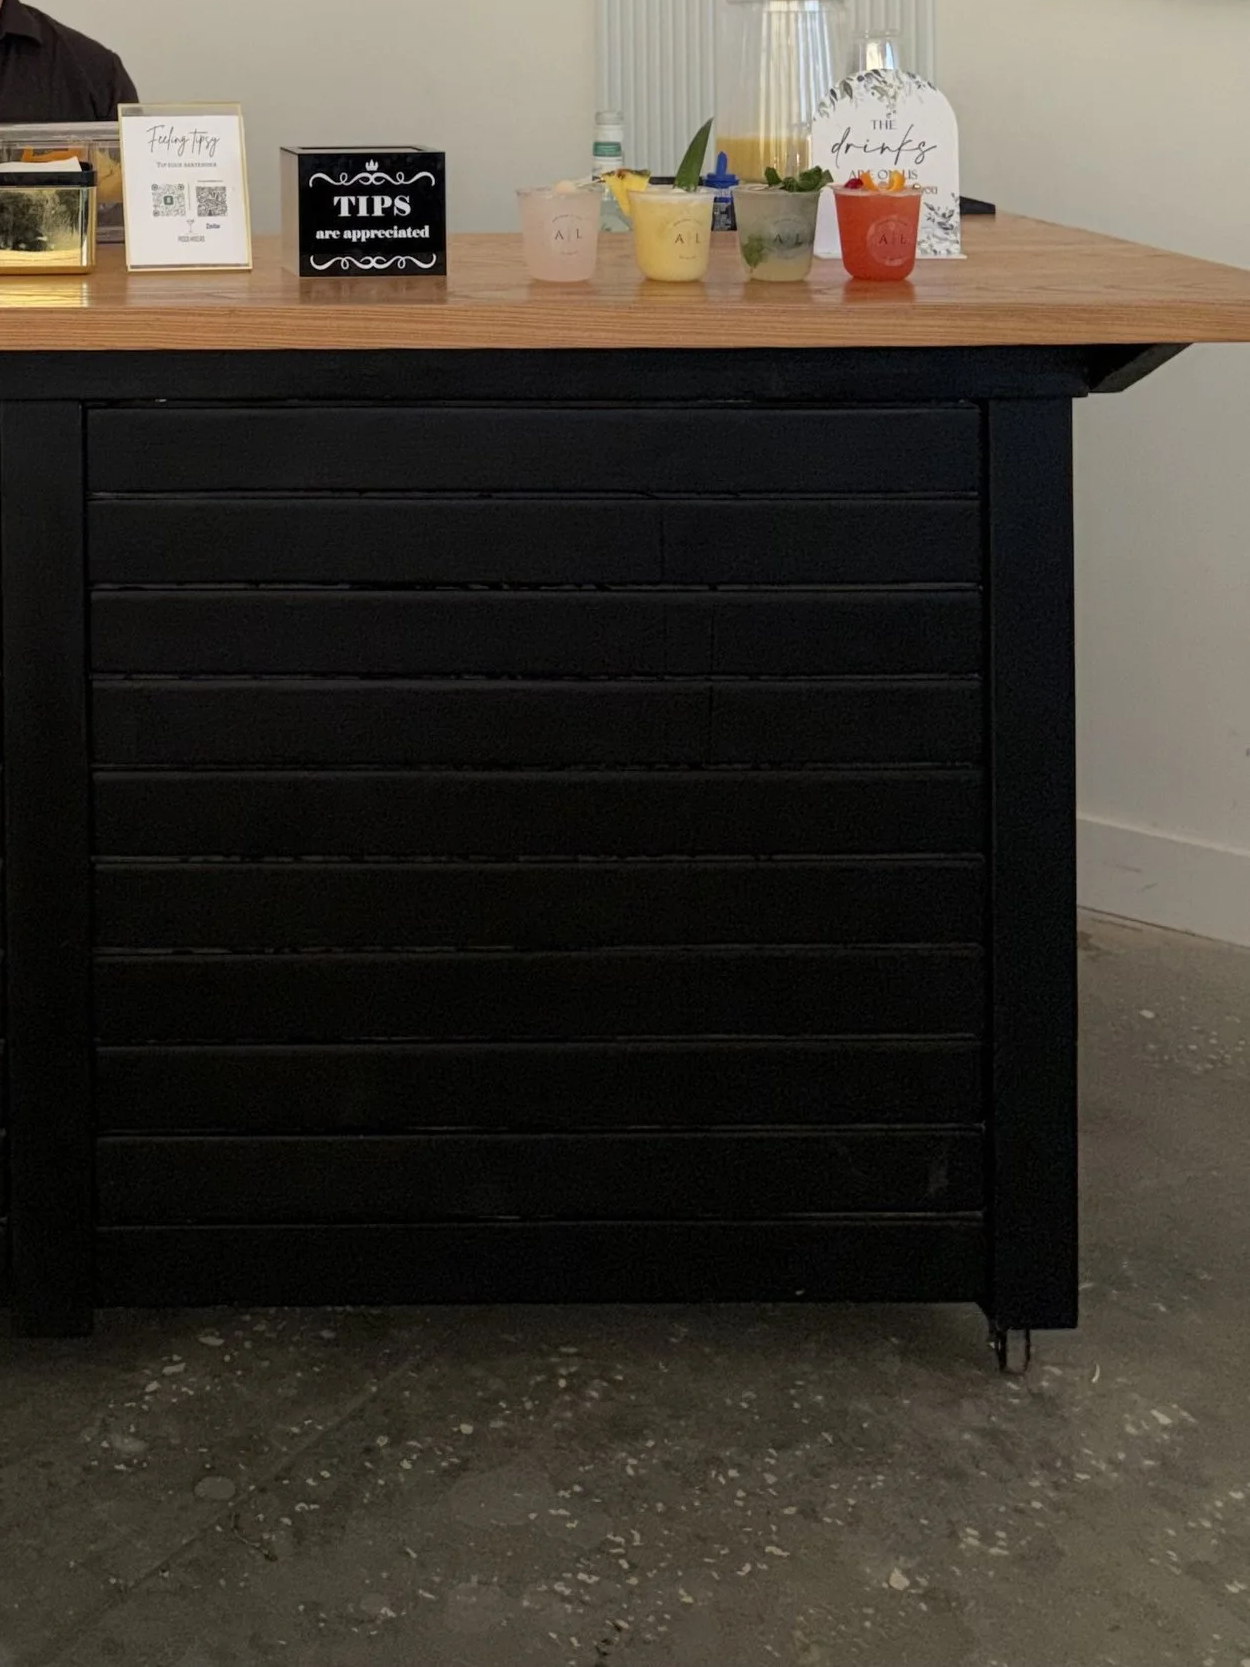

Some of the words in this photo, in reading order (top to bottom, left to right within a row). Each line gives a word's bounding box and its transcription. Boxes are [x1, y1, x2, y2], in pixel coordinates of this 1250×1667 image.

[870, 119, 897, 131] THE
[146, 124, 190, 157] Feeling
[831, 124, 938, 169] drinks
[333, 194, 412, 217] TIPS
[315, 229, 341, 240] are
[343, 225, 430, 243] appreciated
